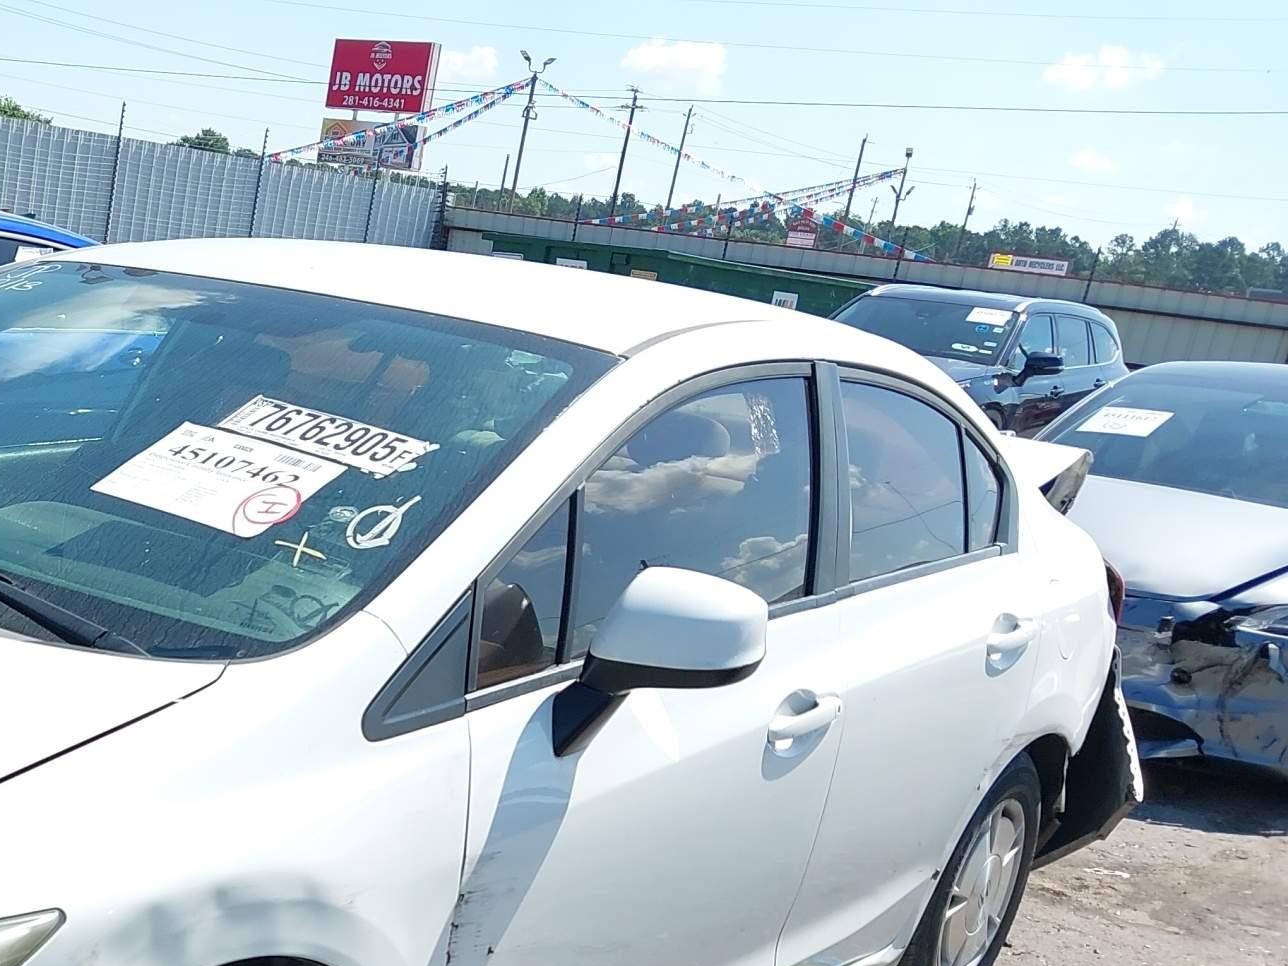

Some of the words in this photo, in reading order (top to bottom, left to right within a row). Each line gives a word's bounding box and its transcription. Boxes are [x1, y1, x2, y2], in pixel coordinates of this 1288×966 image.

[332, 72, 352, 91] JB
[355, 73, 423, 96] MOTORS
[342, 95, 405, 109] 281-416-4341
[168, 444, 300, 487] 45107462
